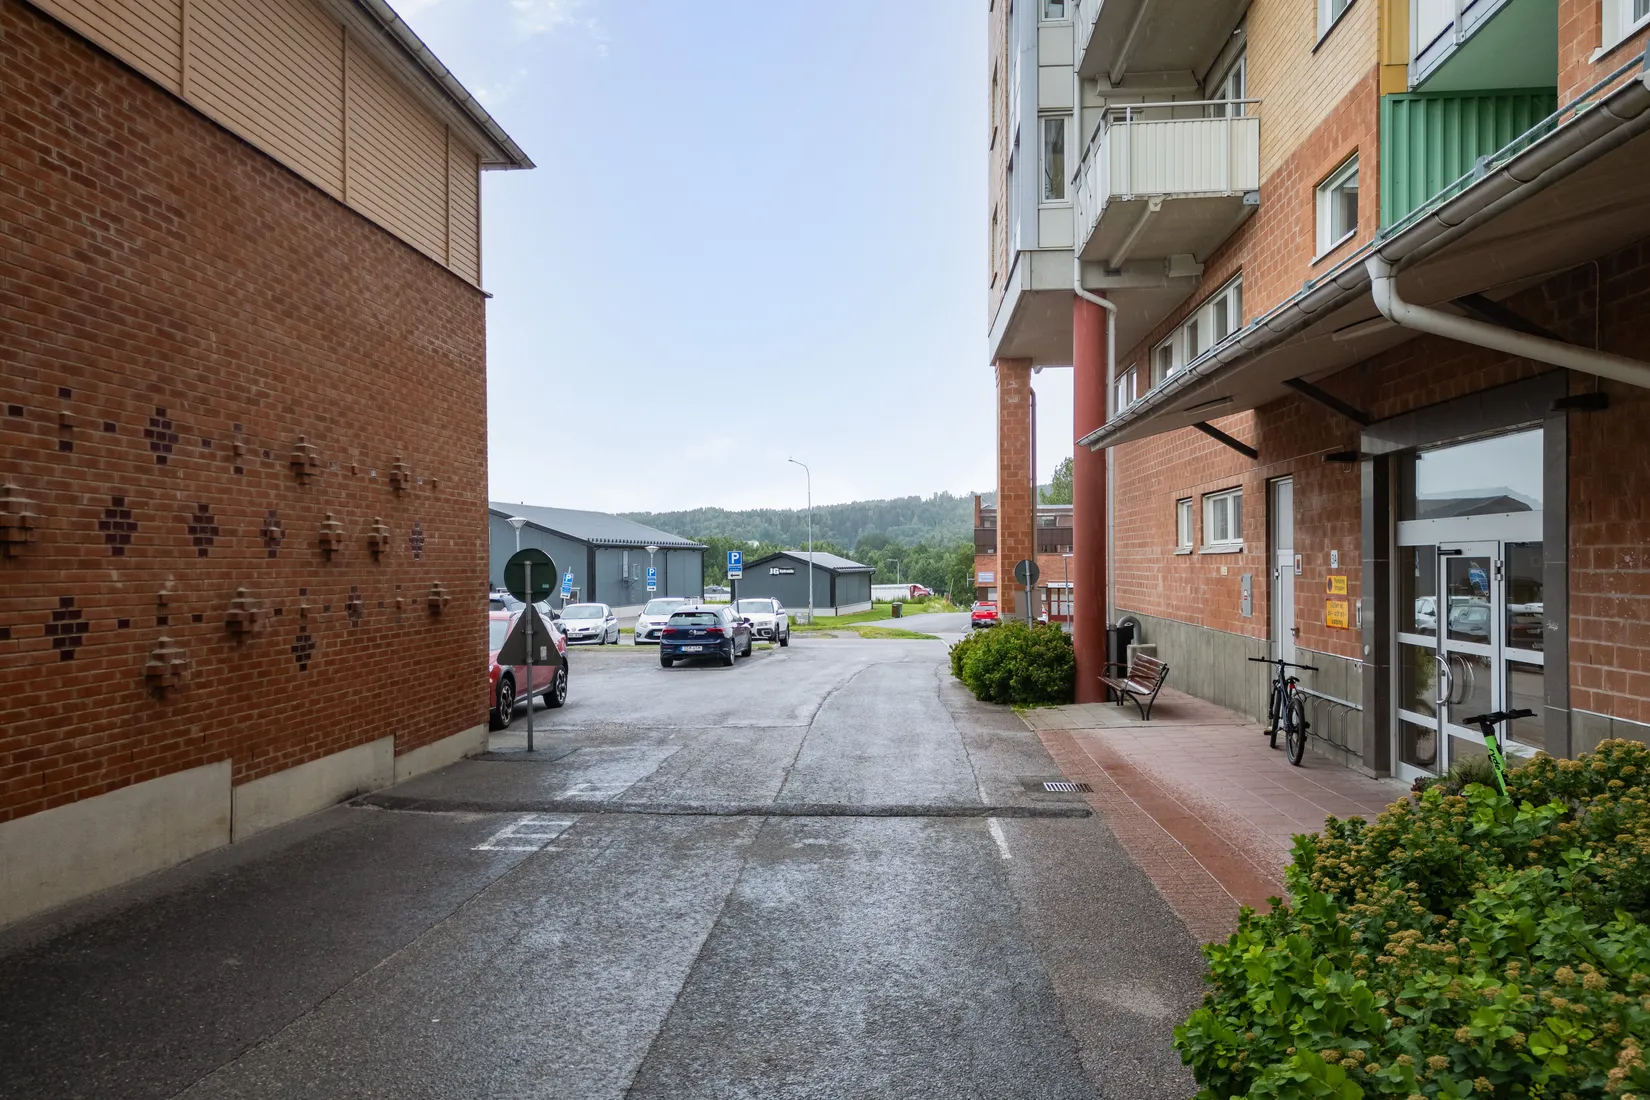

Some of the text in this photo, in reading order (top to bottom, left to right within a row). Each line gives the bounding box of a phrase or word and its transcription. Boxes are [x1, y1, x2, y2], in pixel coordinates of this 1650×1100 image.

[732, 553, 739, 564] P
[649, 568, 655, 576] P
[769, 567, 780, 575] JG
[1488, 748, 1501, 771] ryde
